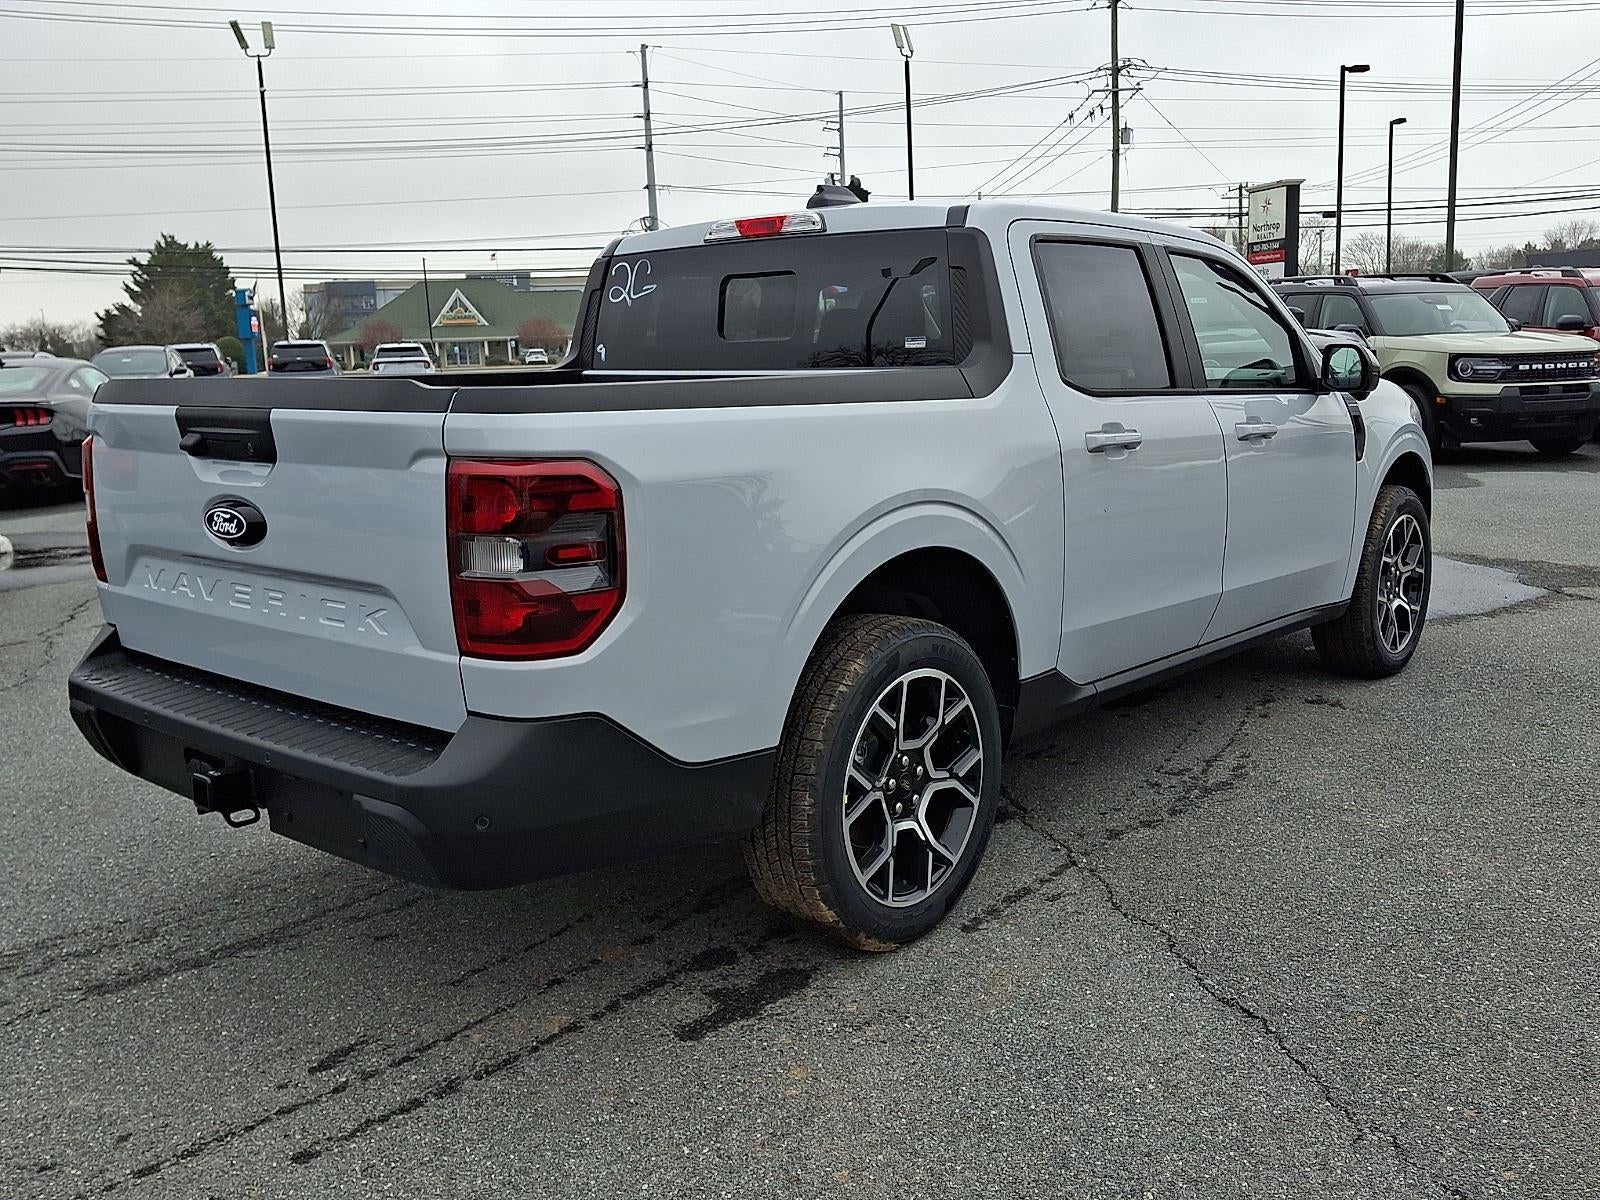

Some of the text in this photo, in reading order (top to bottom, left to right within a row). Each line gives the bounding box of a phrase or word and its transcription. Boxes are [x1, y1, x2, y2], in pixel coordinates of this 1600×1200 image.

[1252, 221, 1280, 232] Northrop
[1257, 232, 1274, 240] REALTY
[1519, 361, 1587, 370] BRONCO
[212, 512, 237, 535] Ford
[144, 565, 388, 636] MAVERICK
